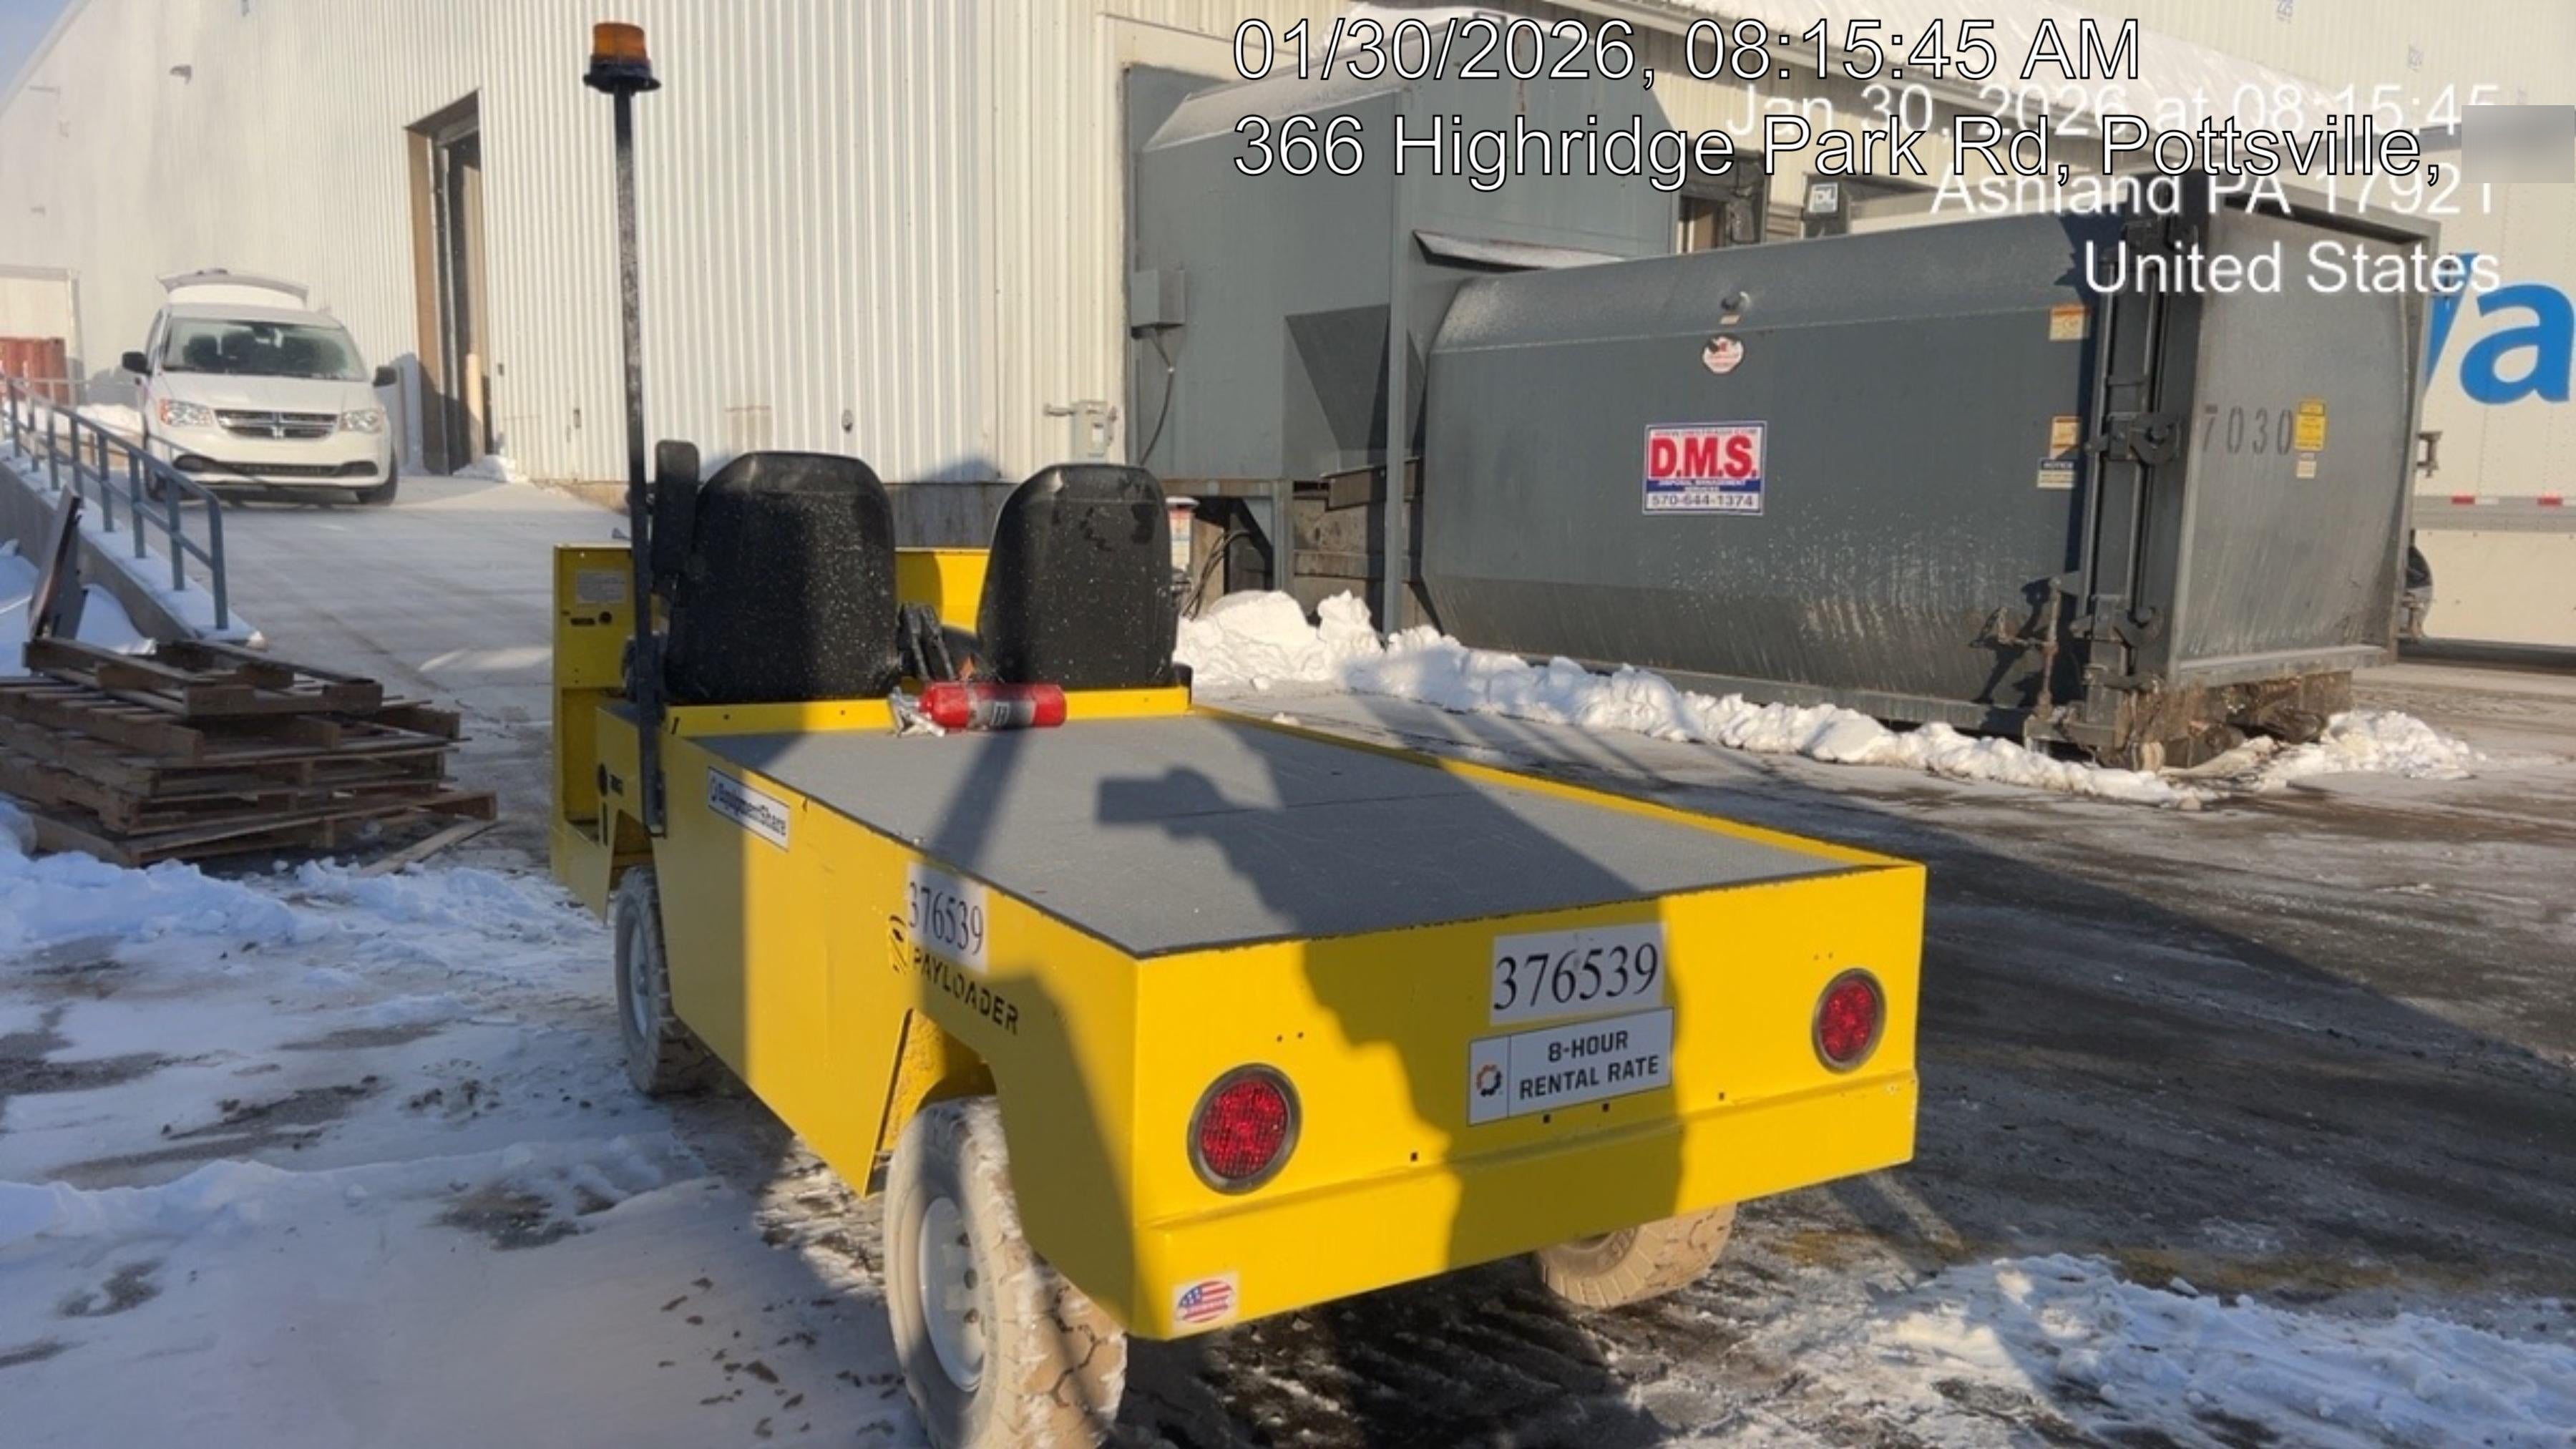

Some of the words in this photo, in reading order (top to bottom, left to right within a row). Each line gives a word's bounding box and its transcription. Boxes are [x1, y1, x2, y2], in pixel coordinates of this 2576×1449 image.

[2202, 405, 2293, 455] 7030
[1650, 436, 1757, 478] D.M.S.
[909, 882, 984, 956] 376539
[912, 947, 1019, 1035] PAYLOADER
[1493, 942, 1658, 1011] 376539
[1548, 1030, 1629, 1063] 8-HOUR
[1519, 1068, 1600, 1100] RENTAL
[1607, 1055, 1659, 1083] RATE
